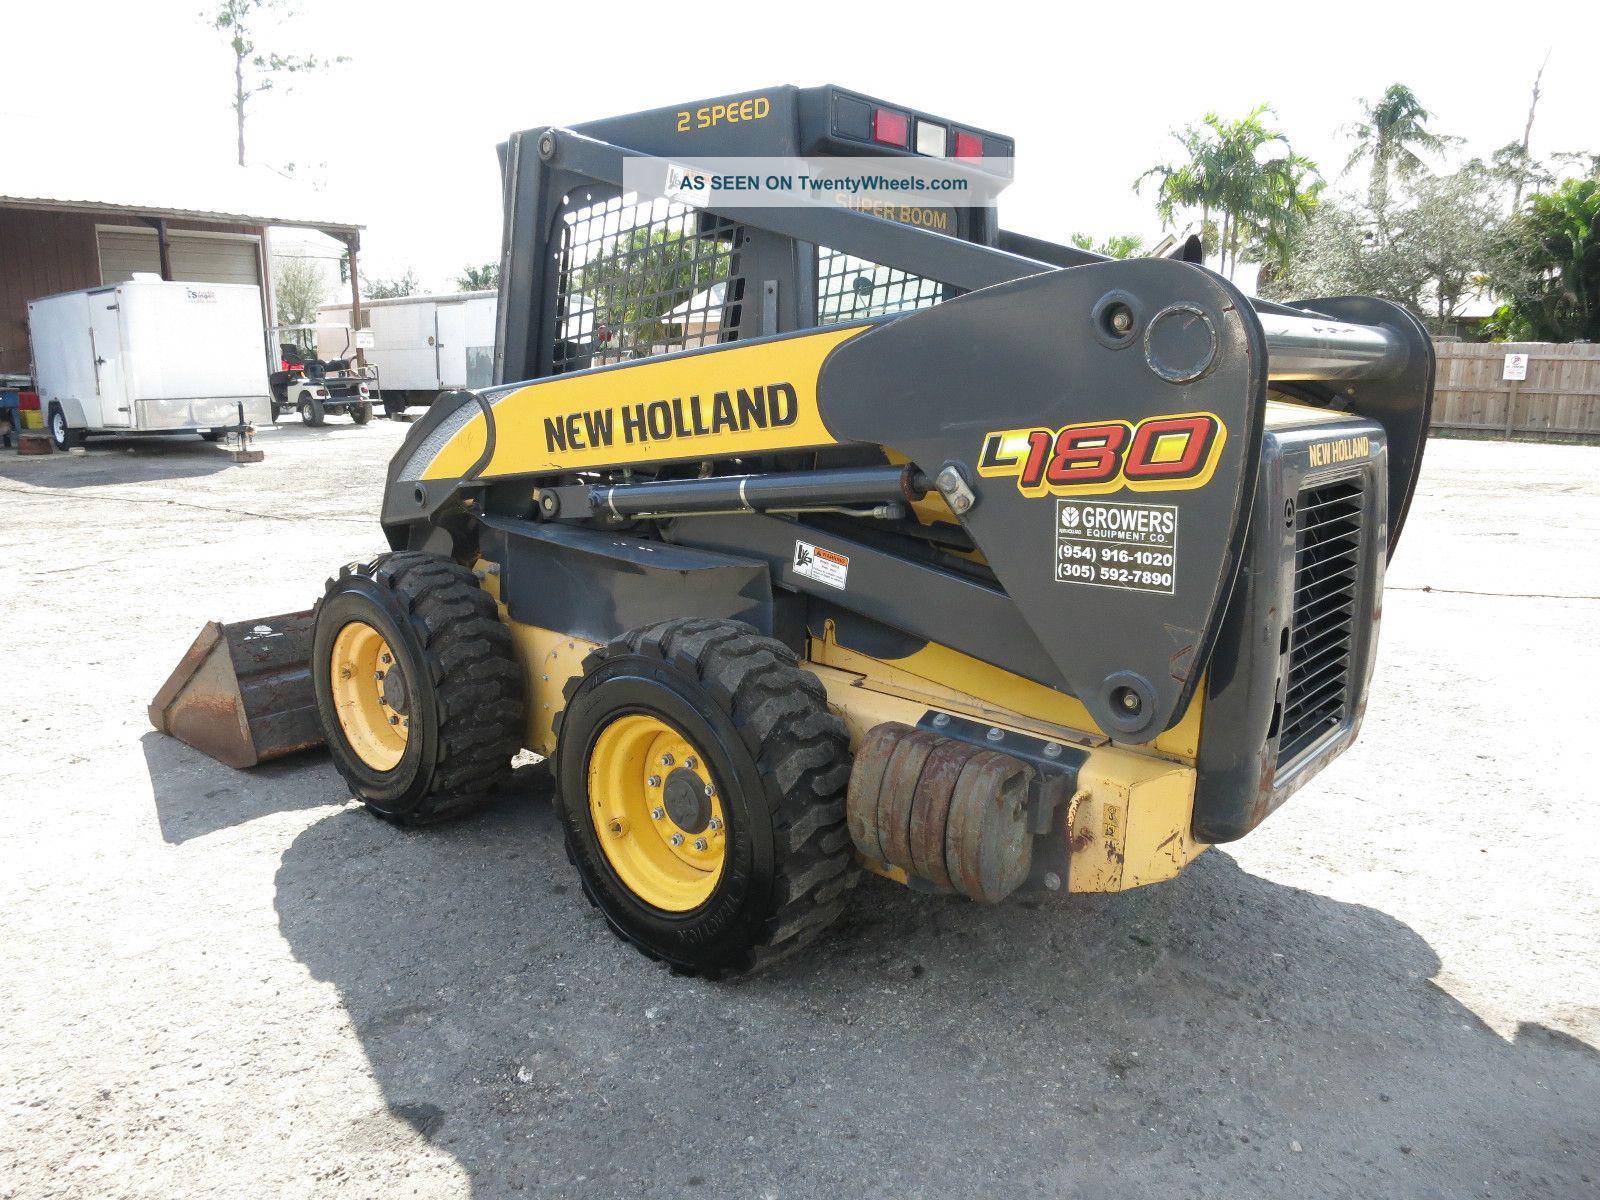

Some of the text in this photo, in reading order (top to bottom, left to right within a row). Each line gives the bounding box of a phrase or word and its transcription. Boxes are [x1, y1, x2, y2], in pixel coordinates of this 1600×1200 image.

[677, 97, 770, 132] 2 SPEED
[835, 192, 947, 229] SUPER BOOM
[543, 381, 799, 453] NEW HOLLAND
[979, 412, 1225, 495] L180
[1309, 436, 1369, 468] NEW HOLLAND
[1082, 506, 1174, 534] GROWERS
[1086, 528, 1146, 541] EQUIPMENT
[1149, 533, 1168, 543] CO.
[1058, 545, 1173, 567] (954) 916-1020
[1057, 563, 1172, 587] (305) 592-7890
